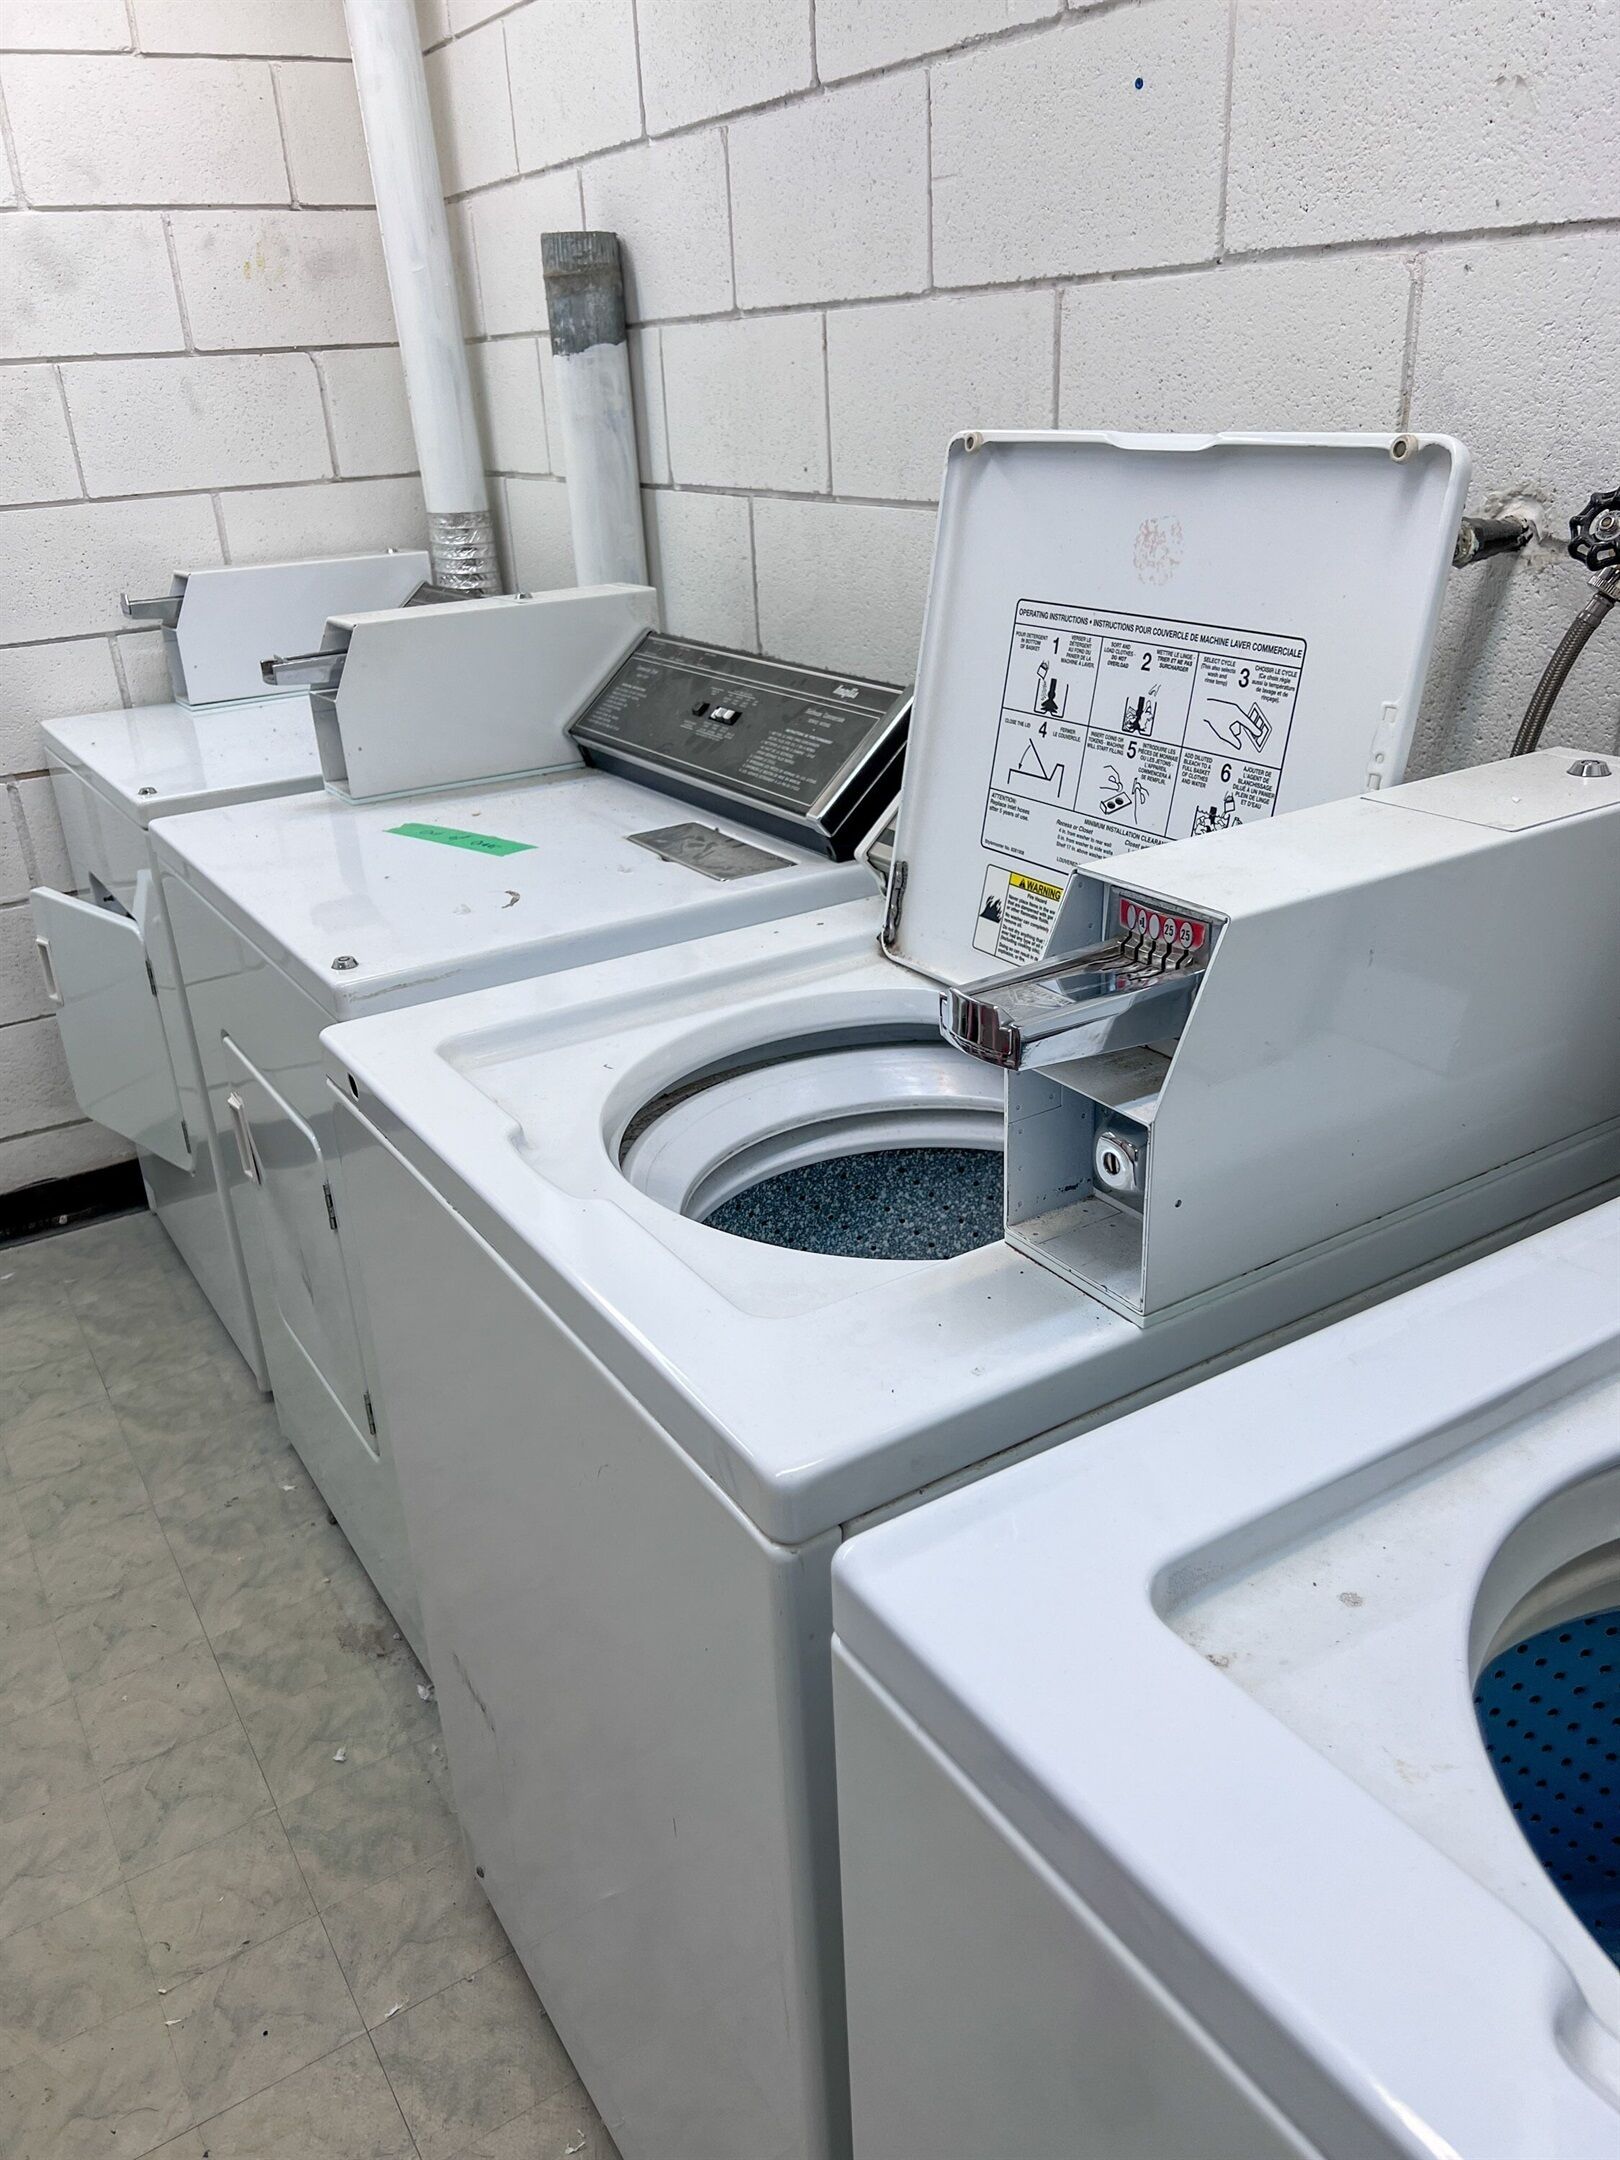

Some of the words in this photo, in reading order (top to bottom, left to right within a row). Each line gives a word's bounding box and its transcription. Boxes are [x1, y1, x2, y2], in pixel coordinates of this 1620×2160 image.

[1019, 608, 1048, 619] OPERATING
[1049, 612, 1088, 625] INSTRUCTIONS
[1093, 620, 1134, 631] INSTRUCTIONS
[1135, 625, 1151, 634] POUR
[1152, 628, 1189, 640] COUVERCLE
[1190, 633, 1198, 641] DE
[1200, 635, 1229, 646] MACHINE
[1230, 639, 1251, 649] LAVER
[1252, 643, 1302, 657] COMMERCIALE
[1053, 637, 1059, 654] 1
[1141, 652, 1152, 671] 2
[1255, 665, 1273, 673] CHOISIR
[1238, 668, 1250, 688] 3
[1039, 722, 1047, 738] 4
[1127, 741, 1137, 759] 5
[1194, 755, 1212, 763] DILUTED
[1221, 763, 1232, 782] 6
[1243, 766, 1264, 775] AJOUTER
[1188, 773, 1207, 781] CLOTHES
[1191, 780, 1206, 788] WATER
[1238, 779, 1272, 791] BLANCHISSAGE
[1256, 796, 1269, 804] LINGE
[1078, 825, 1092, 834] Closet
[1106, 825, 1139, 839] INSTALLATION
[1027, 881, 1061, 900] WARNING
[1164, 924, 1174, 936] 25
[1180, 929, 1190, 941] 25
